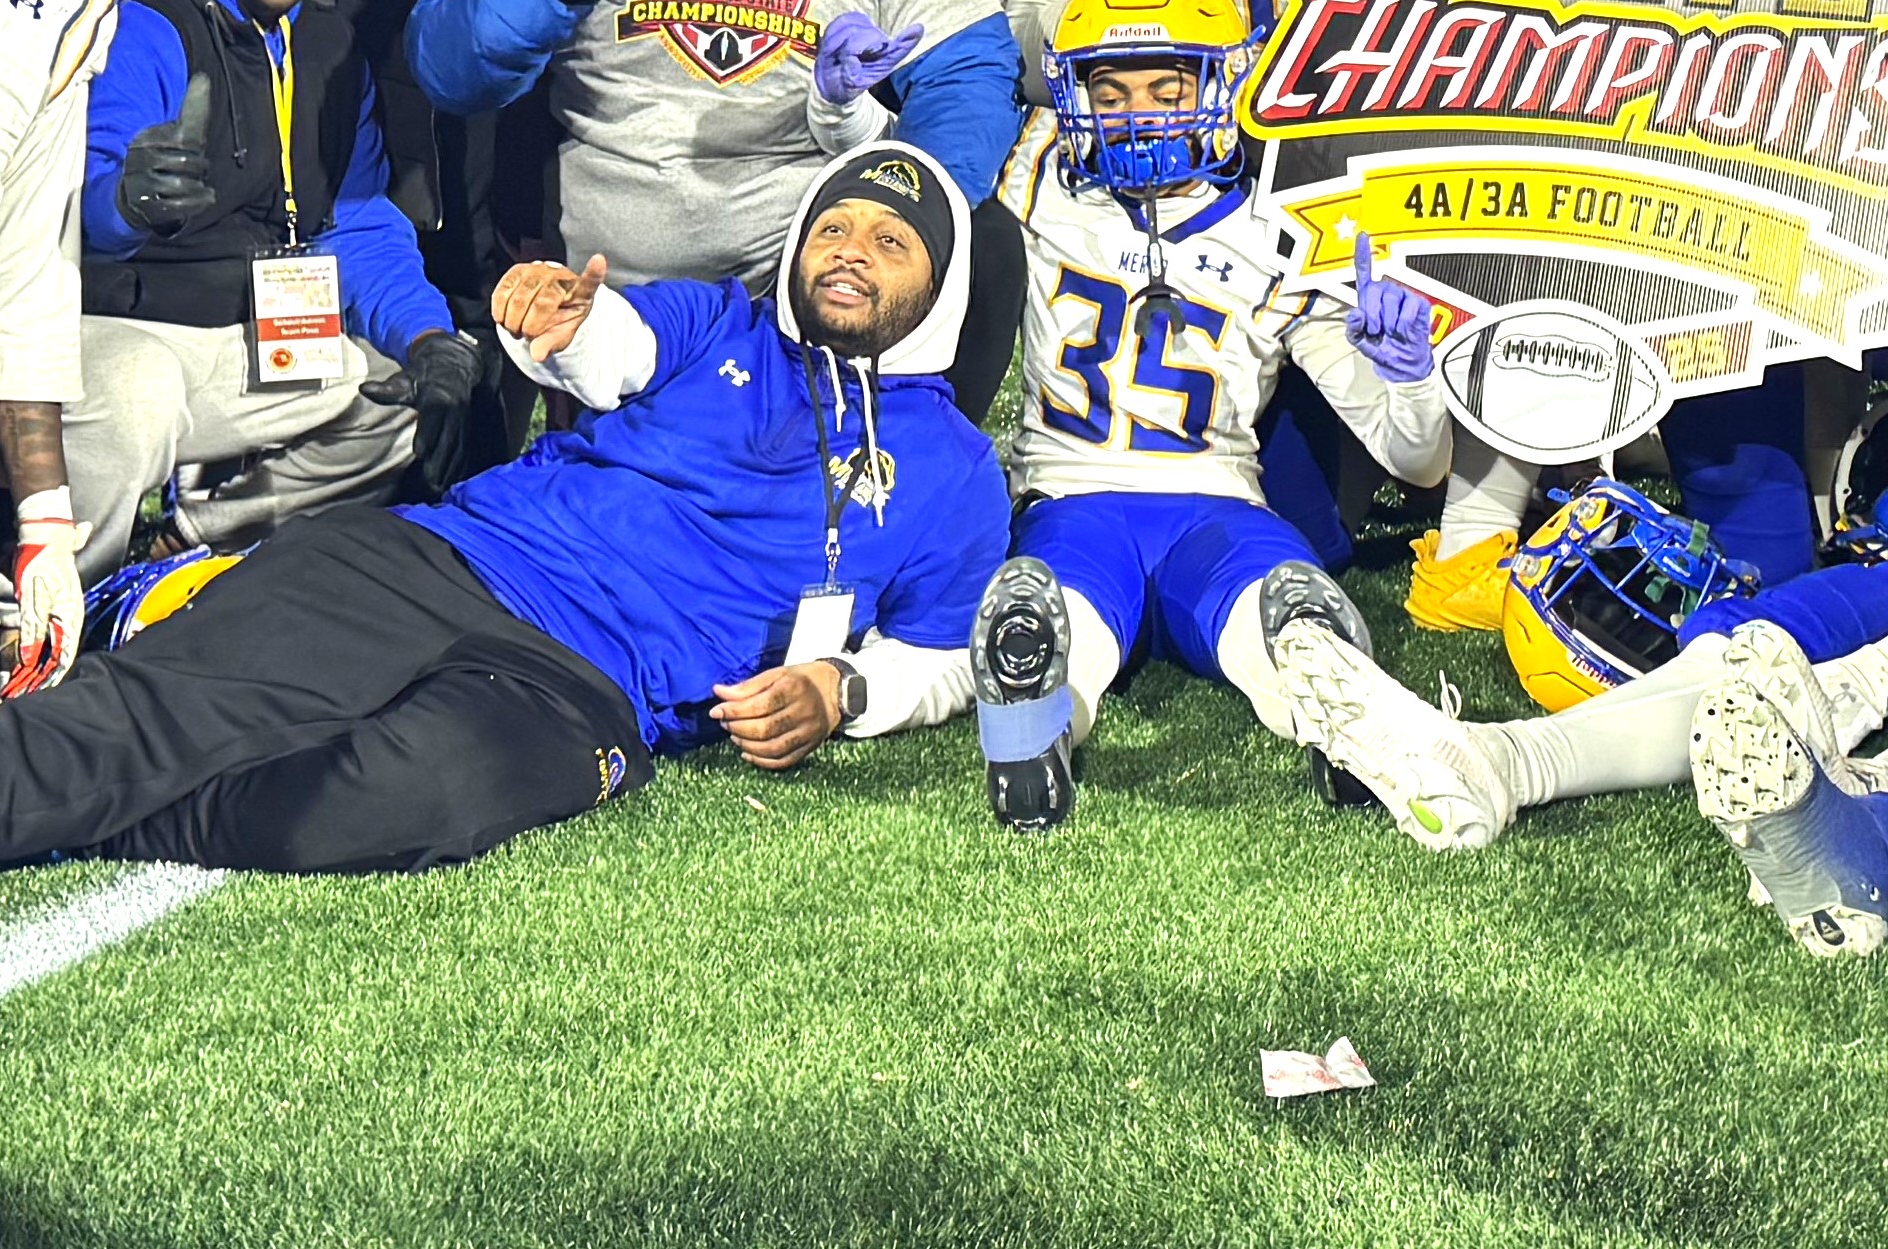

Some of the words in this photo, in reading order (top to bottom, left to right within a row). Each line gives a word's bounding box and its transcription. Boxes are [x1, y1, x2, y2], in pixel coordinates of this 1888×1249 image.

[633, 0, 818, 44] CHAMPIONSHIPS
[1403, 177, 1528, 221] 4A/3A
[1547, 182, 1751, 262] FOOTBALL
[1042, 263, 1232, 458] 35
